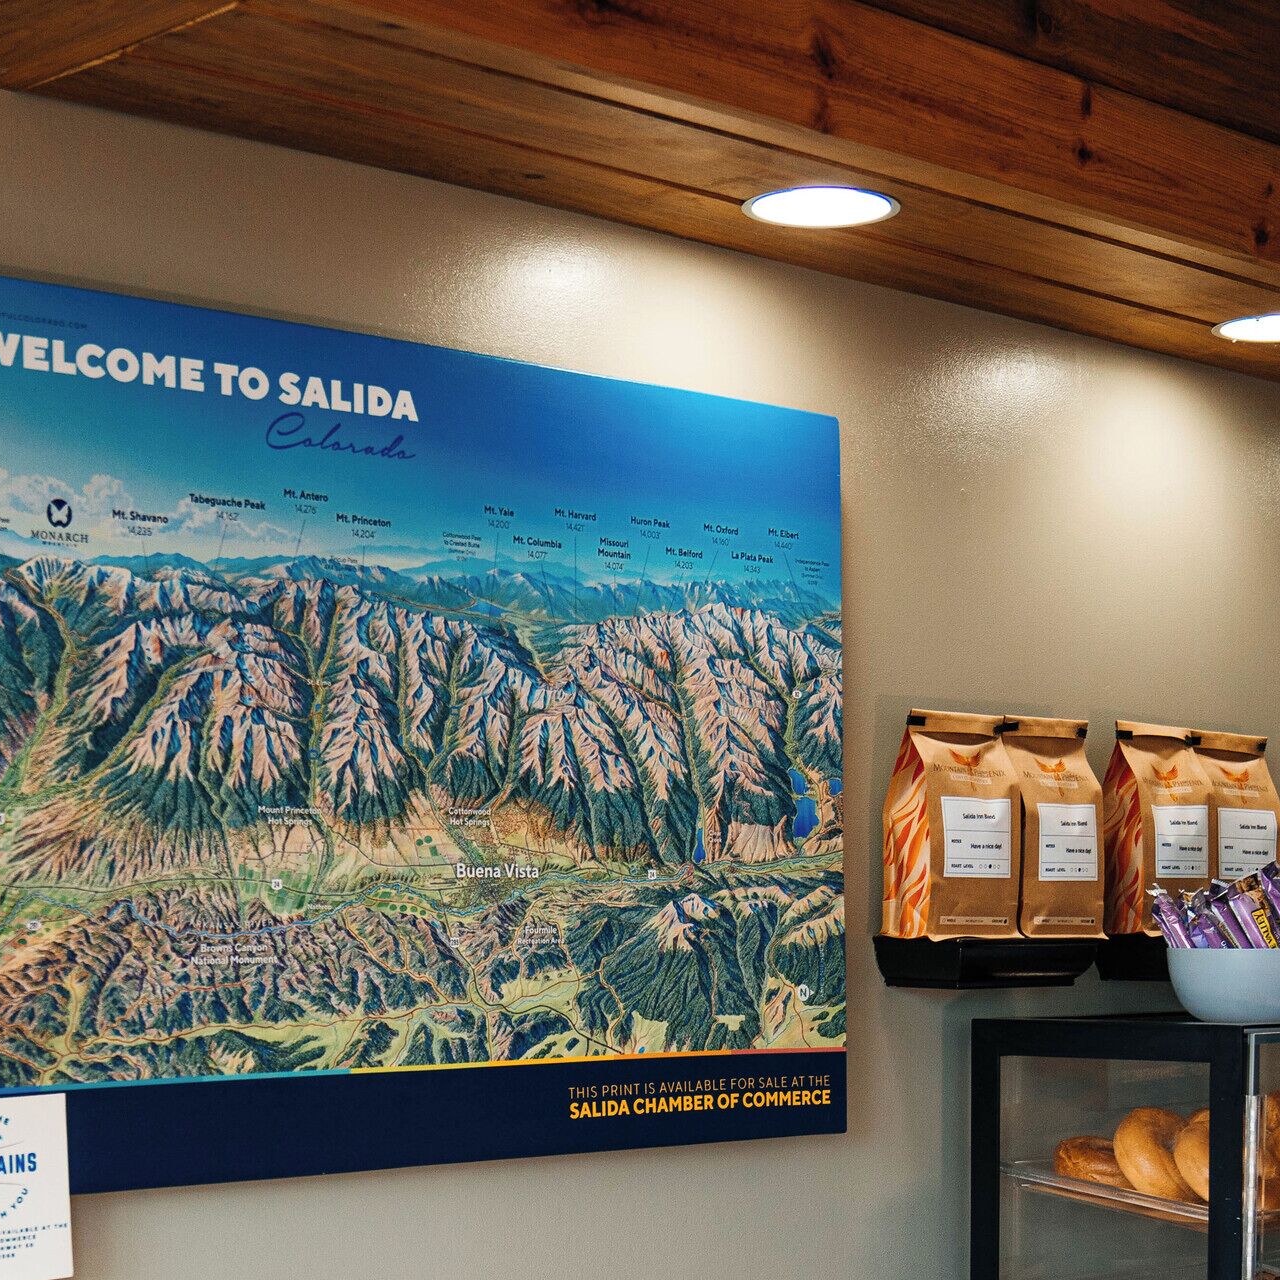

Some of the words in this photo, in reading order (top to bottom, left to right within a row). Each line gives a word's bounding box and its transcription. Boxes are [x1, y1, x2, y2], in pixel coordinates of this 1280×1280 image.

[214, 363, 270, 401] TO
[279, 372, 419, 422] SALIDA
[266, 412, 417, 460] Colorado
[189, 492, 243, 508] Tabeguache
[244, 499, 266, 511] Peak
[283, 488, 298, 499] Mt.
[300, 490, 328, 502] Antero
[112, 509, 127, 520] Mt.
[129, 511, 169, 524] Shavano
[484, 505, 497, 516] Mt.
[499, 506, 514, 517] Yale
[554, 508, 566, 518] Mt.
[568, 509, 597, 521] Harvard
[336, 513, 350, 523] Mt.
[352, 515, 391, 528] Princeton
[630, 516, 652, 526] Huron
[653, 519, 671, 529] Peak
[703, 523, 715, 533] Mt.
[715, 525, 739, 536] Oxford
[780, 530, 800, 540] Elbert
[31, 530, 89, 544] MONARCH
[513, 536, 526, 545] Mt.
[527, 537, 562, 549] Columbia
[600, 537, 629, 548] Missouri
[597, 548, 631, 560] Mountain
[666, 547, 677, 556] Mt.
[678, 548, 703, 559] Belford
[740, 552, 757, 562] Plata
[758, 554, 774, 564] Peak
[258, 806, 283, 814] Mount
[285, 806, 321, 815] Princeton
[448, 807, 491, 815] Cottonwood
[268, 817, 282, 825] Hot
[283, 817, 312, 827] Springs
[450, 818, 463, 826] Hot
[464, 818, 491, 828] Springs
[456, 862, 501, 879] Buena
[504, 862, 540, 879] Vista
[525, 926, 558, 935] Fourmile
[1254, 912, 1274, 944] VALLEY
[200, 944, 233, 953] Browns
[235, 943, 268, 954] Canyon
[190, 956, 228, 965] National
[230, 955, 278, 965] Monument
[568, 1085, 598, 1099] THIS
[602, 1083, 640, 1097] PRINT
[644, 1082, 656, 1094] IS
[659, 1079, 727, 1093] AVAILABLE
[730, 1077, 755, 1090] FOR
[758, 1076, 787, 1089] SALE
[791, 1075, 804, 1087] AT
[808, 1075, 830, 1087] THE
[569, 1099, 630, 1119] SALIDA
[633, 1095, 714, 1114] CHAMBER
[717, 1093, 739, 1110] OF
[742, 1089, 831, 1108] COMMERCE
[10, 1187, 29, 1210] YOU
